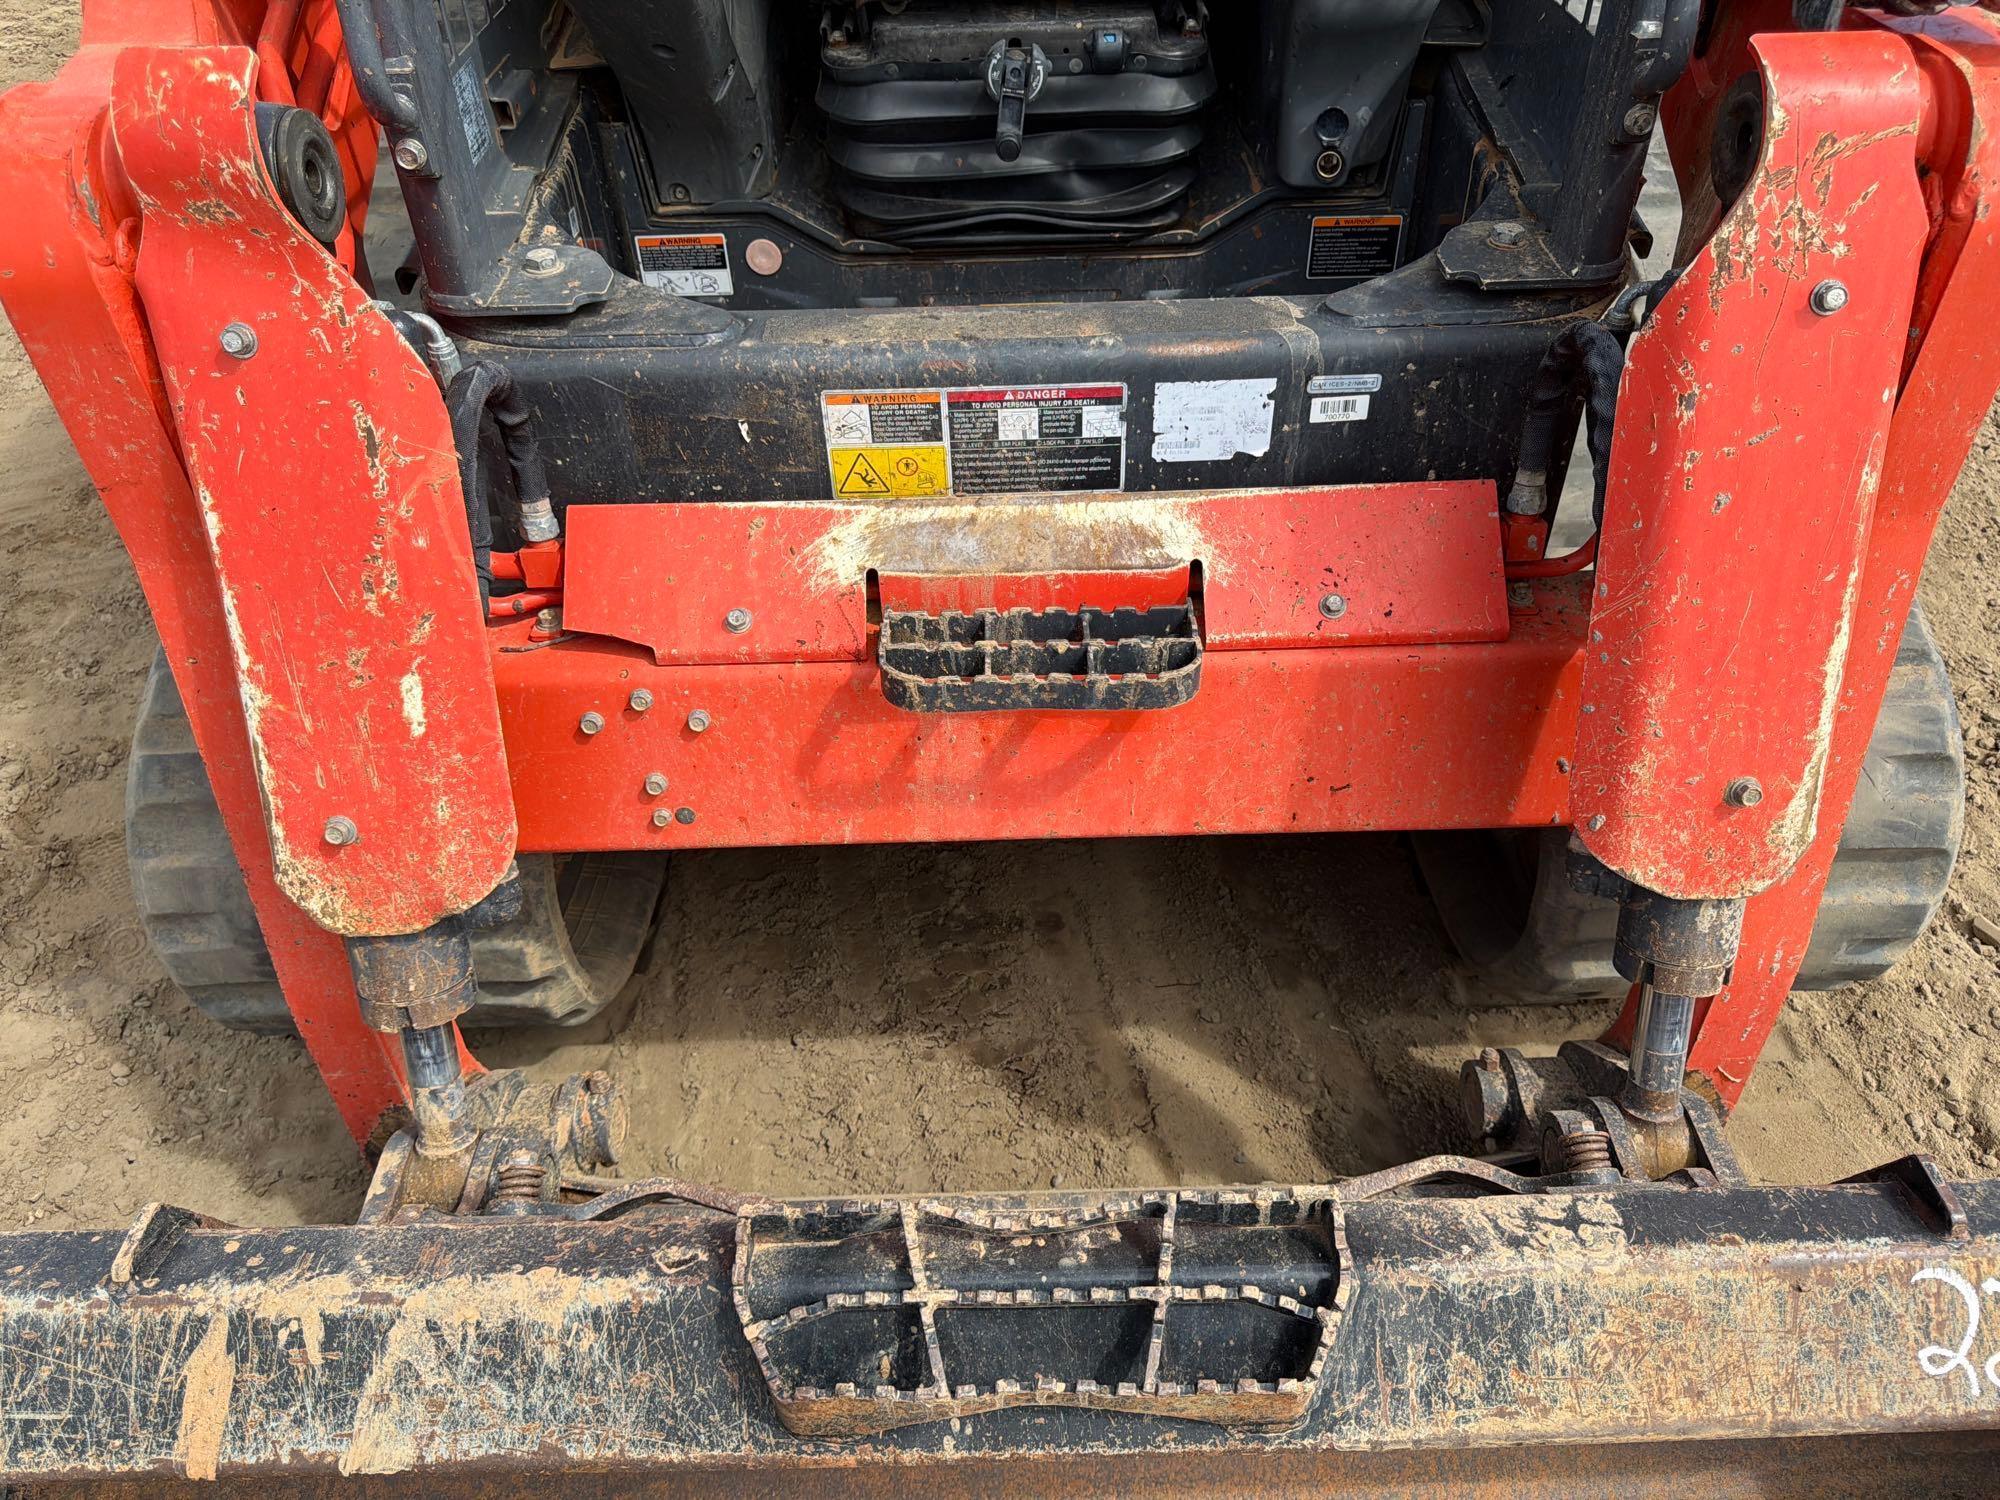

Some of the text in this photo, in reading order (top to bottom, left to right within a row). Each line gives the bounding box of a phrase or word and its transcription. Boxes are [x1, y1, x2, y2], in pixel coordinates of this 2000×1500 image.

[665, 237, 701, 245] WARNING
[1017, 389, 1066, 400] DANGER
[863, 395, 917, 403] WARNING
